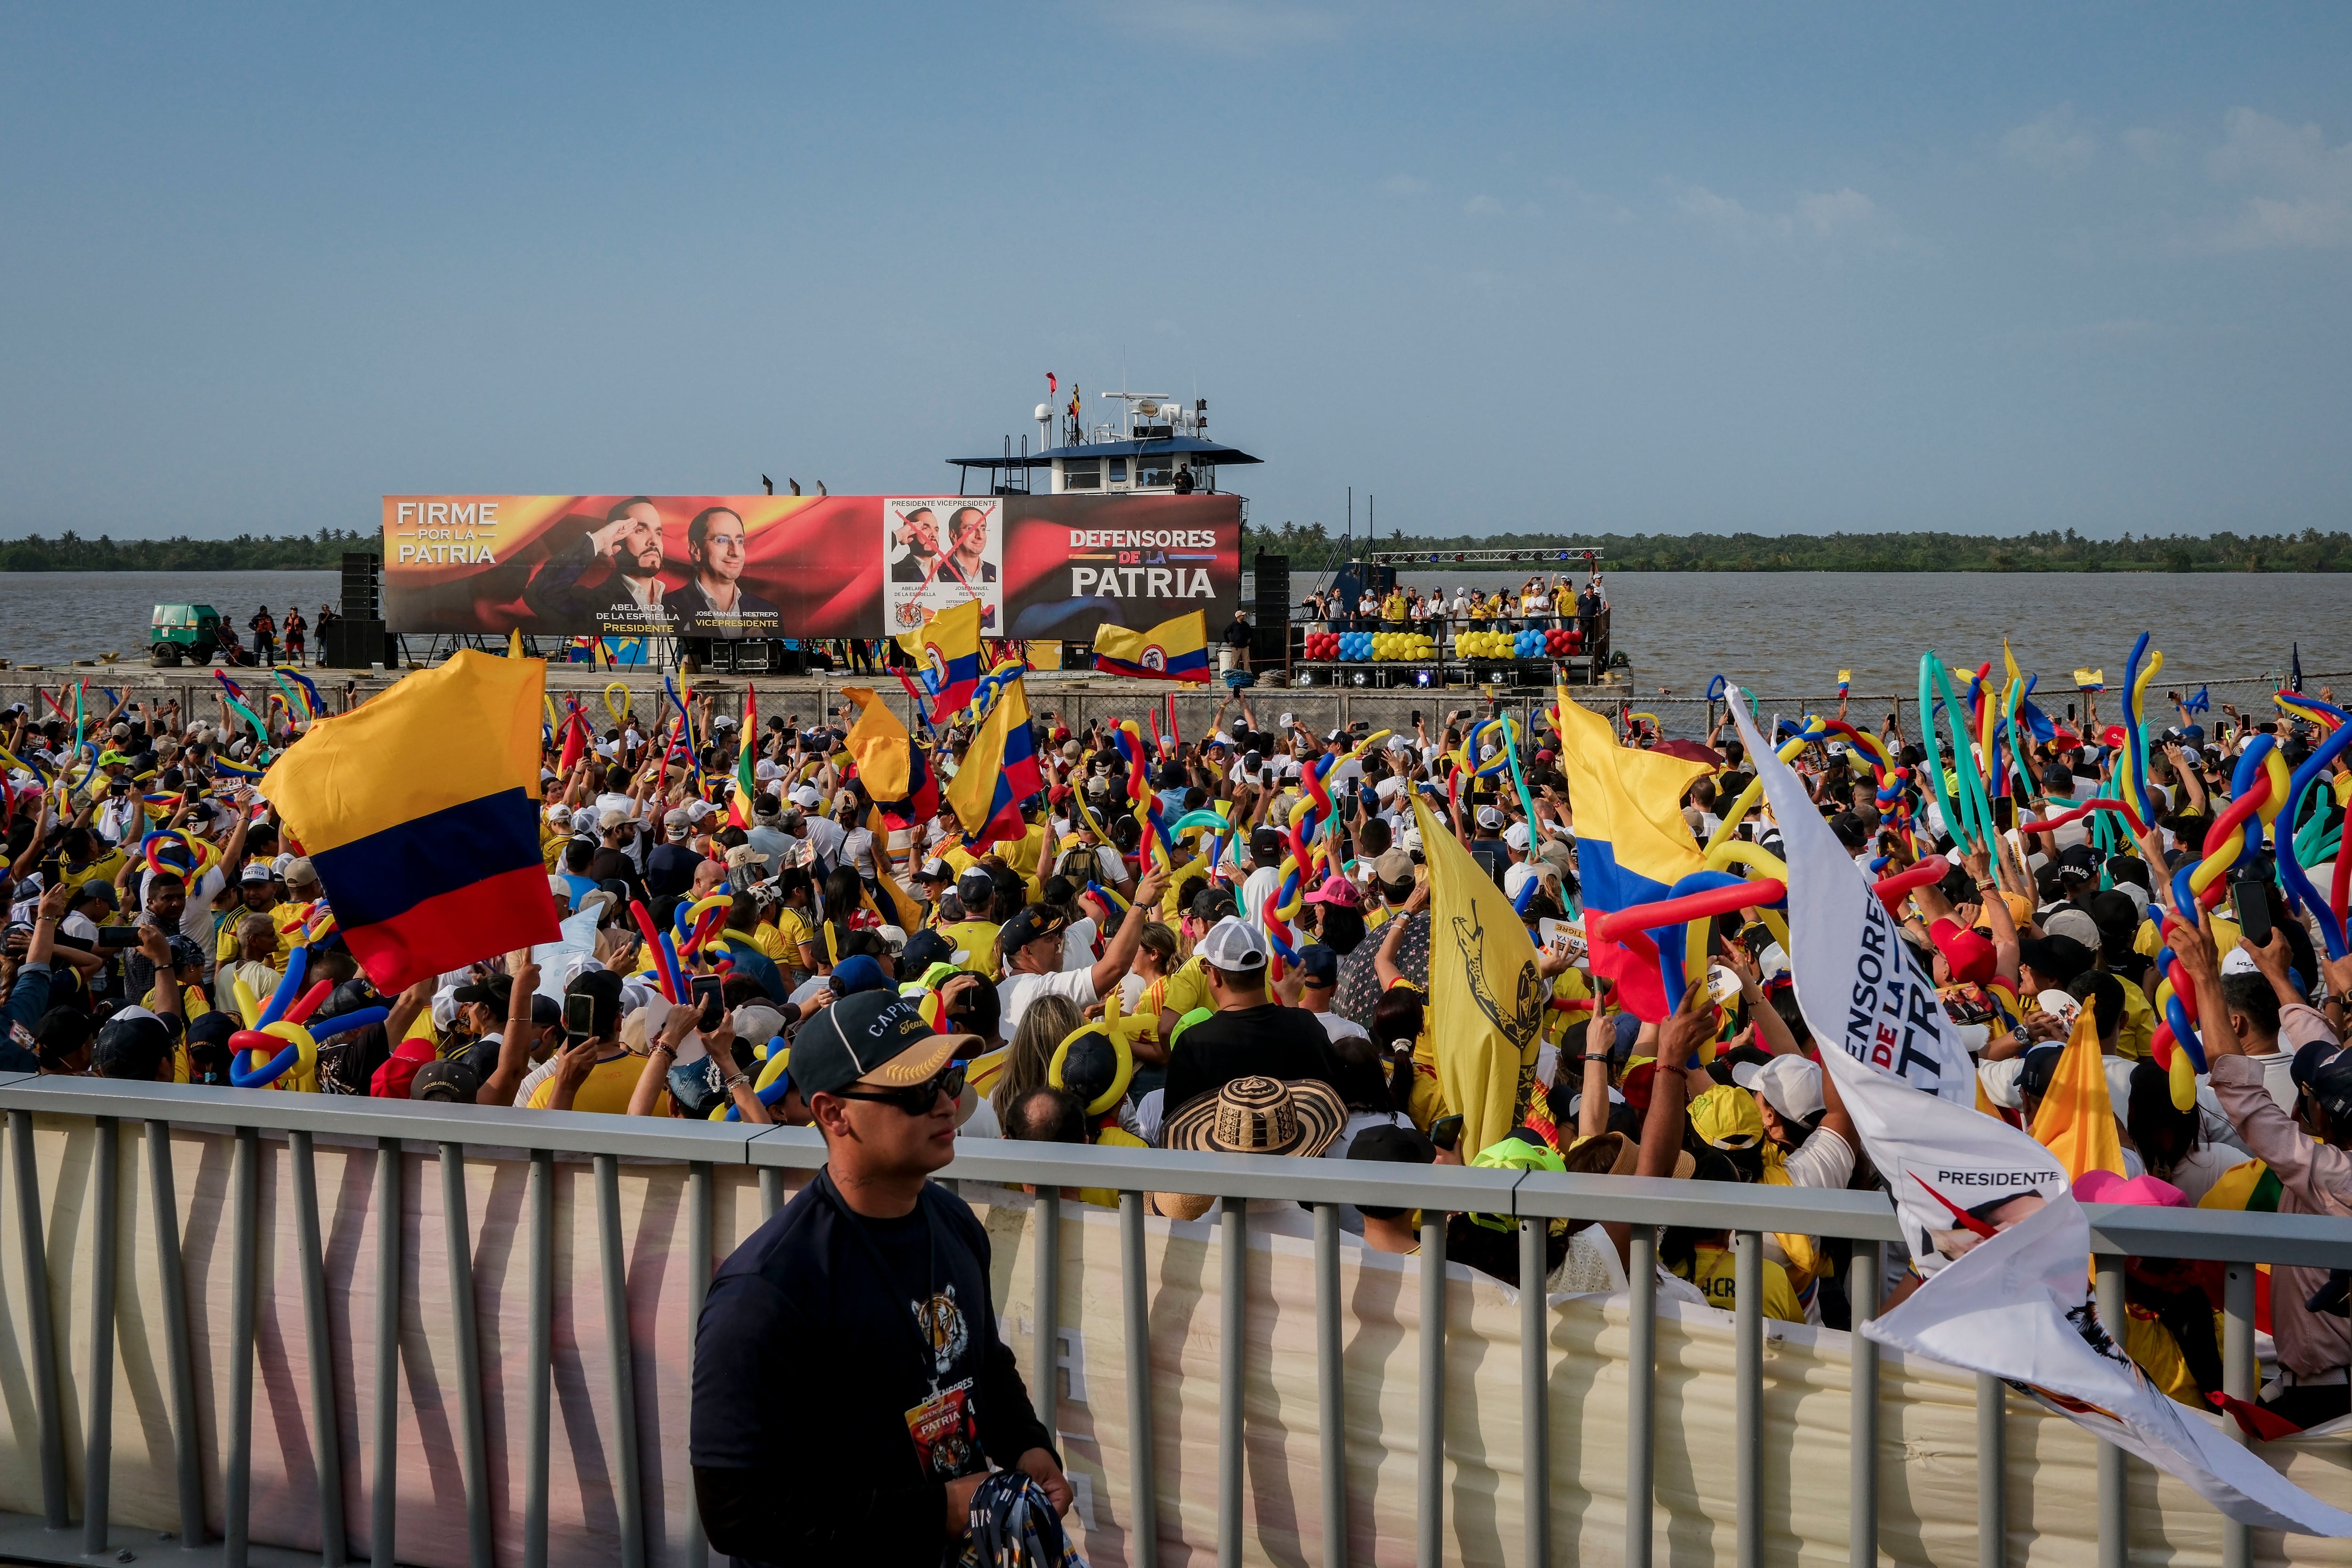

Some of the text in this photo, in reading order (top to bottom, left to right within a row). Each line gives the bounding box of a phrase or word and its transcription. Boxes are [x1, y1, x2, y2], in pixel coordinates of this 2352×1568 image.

[397, 502, 498, 525] FIRME
[418, 529, 475, 540] POR LA
[1070, 530, 1216, 547] DEFENSORES
[399, 545, 497, 563] PATRIA
[1119, 551, 1166, 564] DE LA
[1071, 567, 1216, 598] PATRIA
[2061, 866, 2089, 879] CHAMPS
[899, 1020, 927, 1035] Team
[1871, 980, 1905, 1069] DE LA
[428, 1081, 454, 1090] COLOMBIA
[1939, 1170, 2060, 1186] PRESIDENTE
[917, 1401, 957, 1422] DEFENSORES
[921, 1411, 961, 1435] PATRIA
